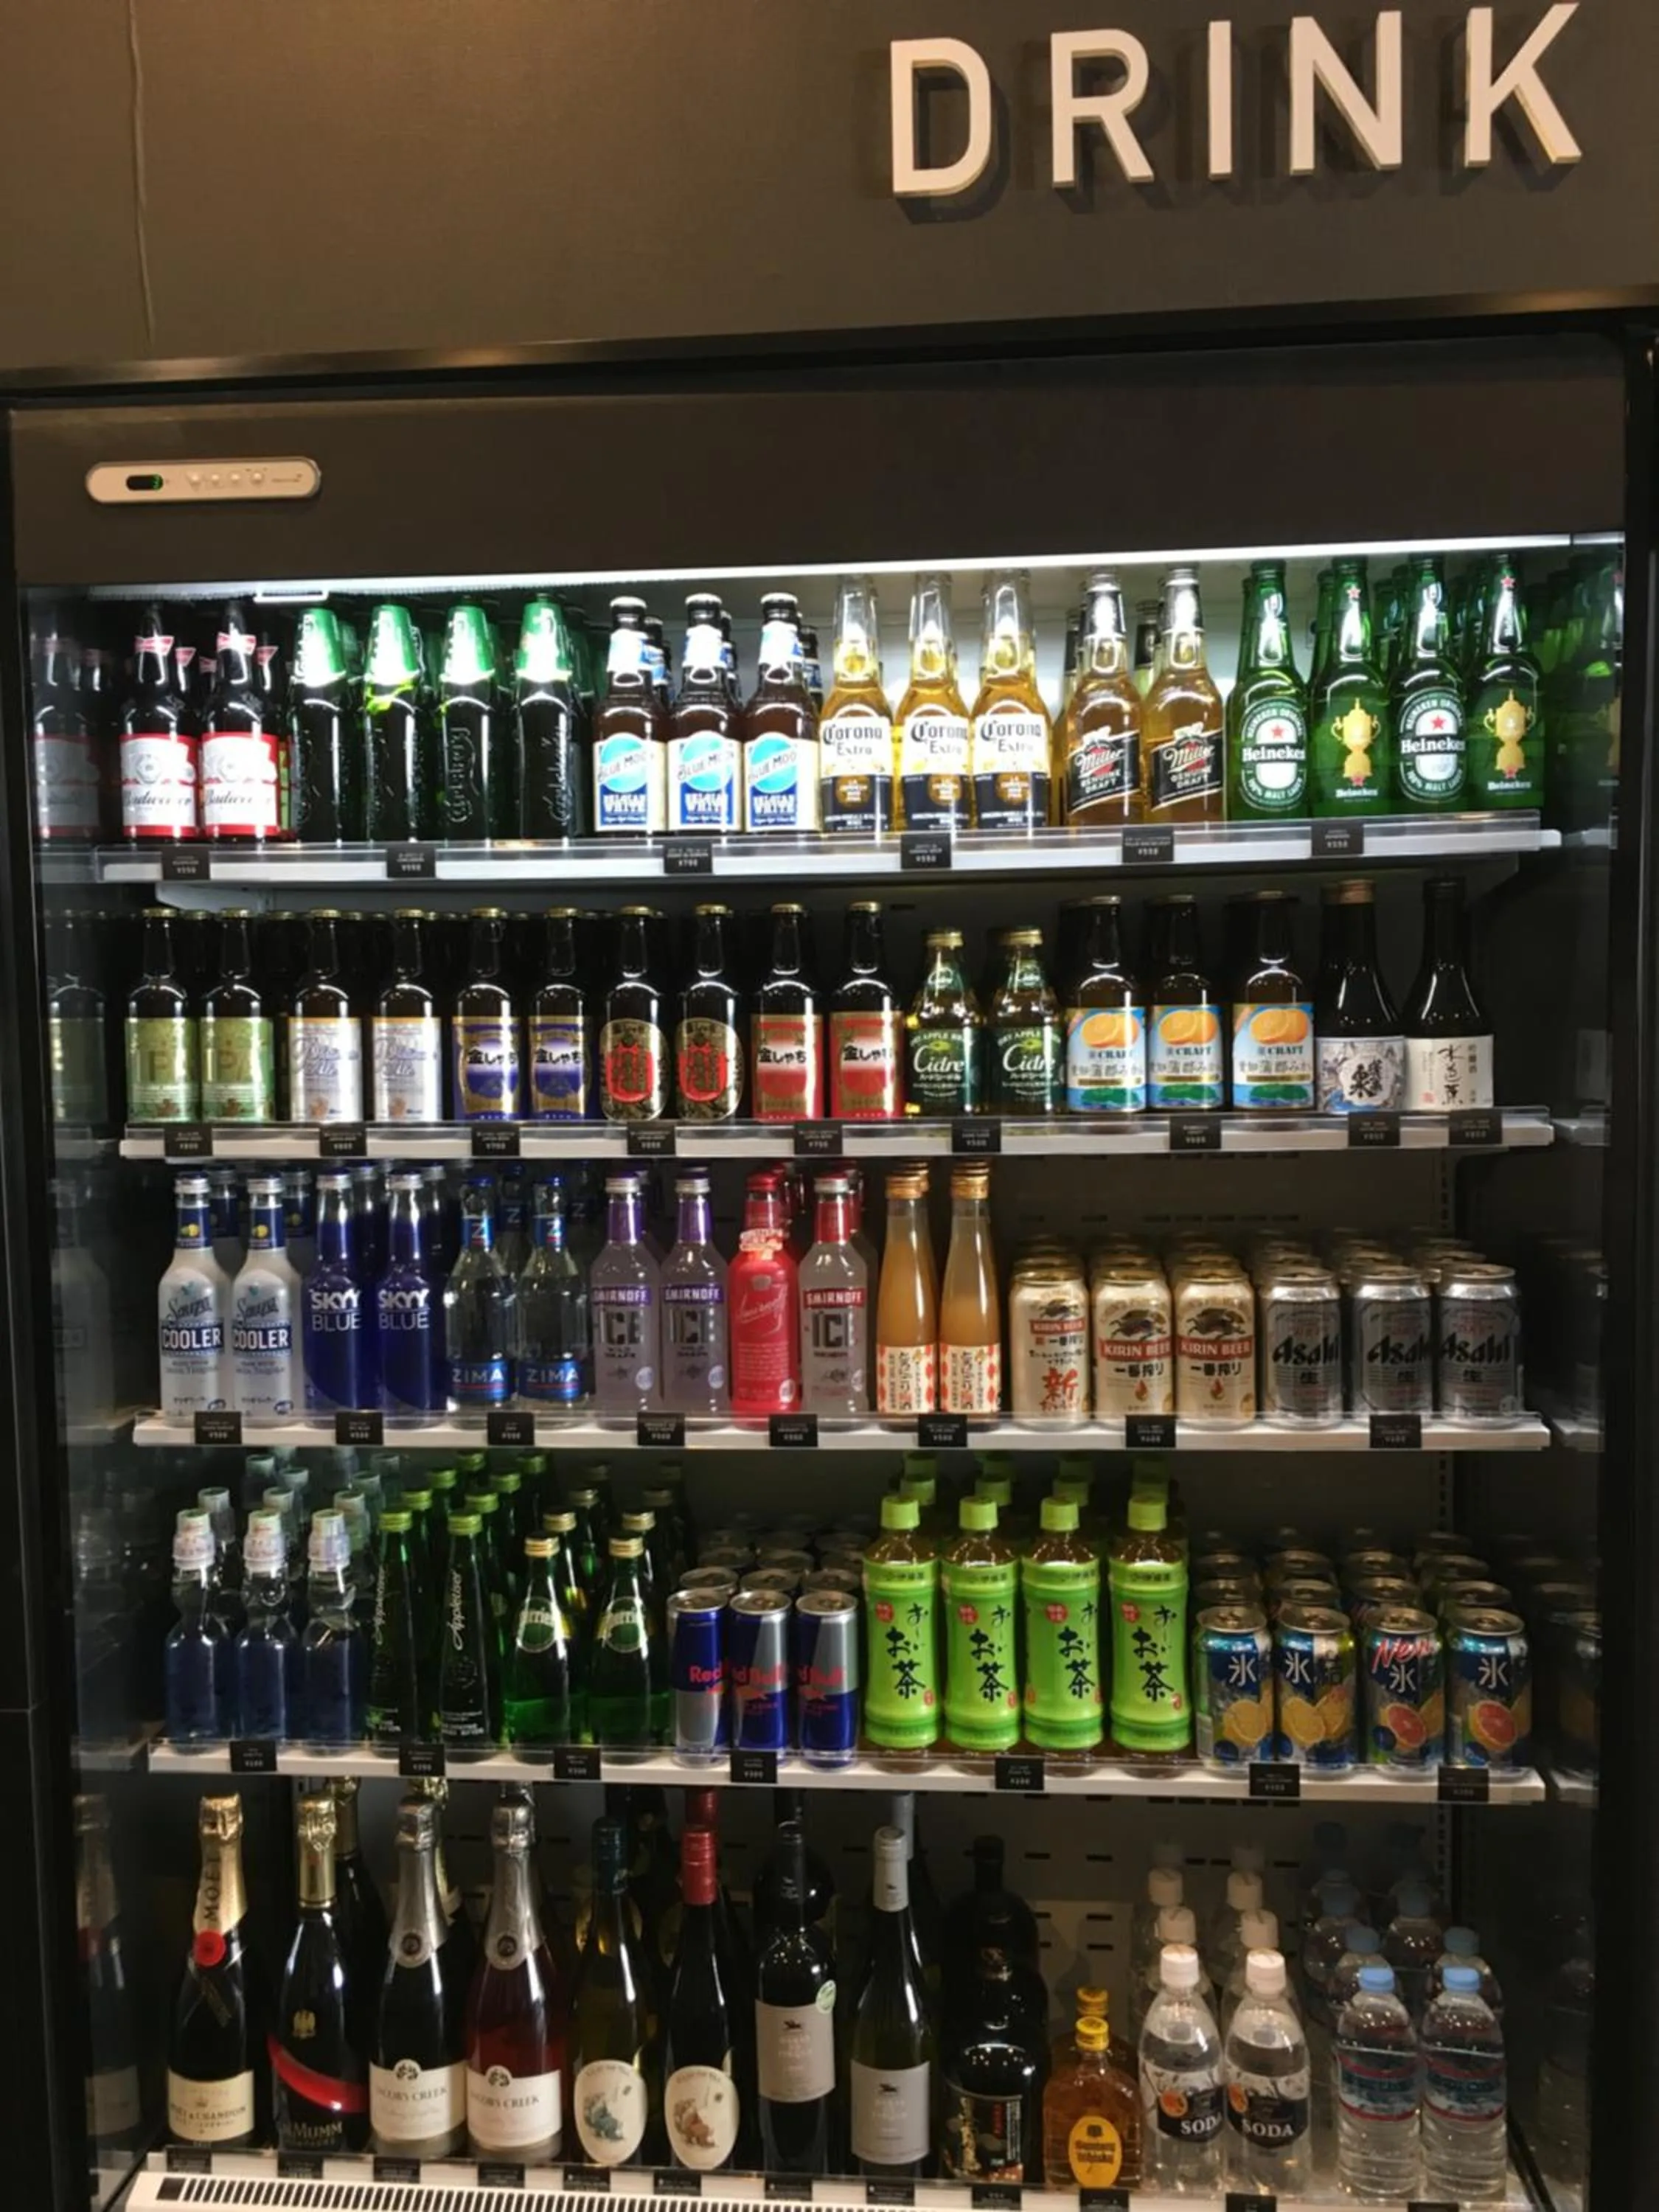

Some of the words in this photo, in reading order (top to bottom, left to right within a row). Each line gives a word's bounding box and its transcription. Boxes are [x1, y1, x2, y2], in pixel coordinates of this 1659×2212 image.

[891, 2, 1582, 196] DRINK
[823, 723, 883, 745] Corona
[836, 742, 872, 756] Extra
[1163, 745, 1215, 769] Miller
[1075, 748, 1125, 774] Miller
[1335, 788, 1379, 799] Heineken
[1487, 780, 1532, 790] Heineken
[535, 1048, 582, 1064] 金しゃち
[758, 1047, 807, 1064] 金しゃち
[914, 1045, 965, 1073] Cidre
[310, 1288, 362, 1310] SKYY
[378, 1288, 430, 1310] SKYY
[665, 1288, 720, 1301] SMIRNOFF
[806, 1290, 862, 1305] SMIRNOFF
[311, 1312, 362, 1332] BLUE
[378, 1311, 430, 1330] BLUE
[162, 1327, 222, 1350] COOLER
[233, 1328, 289, 1350] COOLER
[1181, 1341, 1218, 1356] KIRIN
[1221, 1340, 1251, 1355] BEER
[1441, 1332, 1512, 1365] Asahi
[1104, 1344, 1142, 1357] KIRIN
[1146, 1343, 1171, 1357] BEER
[1272, 1334, 1340, 1365] Asahi
[451, 1368, 504, 1383] ZIMA
[526, 1368, 580, 1382] ZIMA
[1114, 1363, 1164, 1378] 一番搾り
[1190, 1362, 1242, 1377] 一番搾り
[1041, 1366, 1079, 1401] 新
[689, 1663, 723, 1683] Red
[1228, 1653, 1257, 1687] 氷
[1285, 1651, 1311, 1684] 氷
[1478, 1656, 1509, 1689] 氷
[1388, 1663, 1416, 1693] 氷
[294, 2121, 343, 2138] MUMM
[1181, 2115, 1220, 2135] SOD
[1242, 2118, 1294, 2138] SODA
